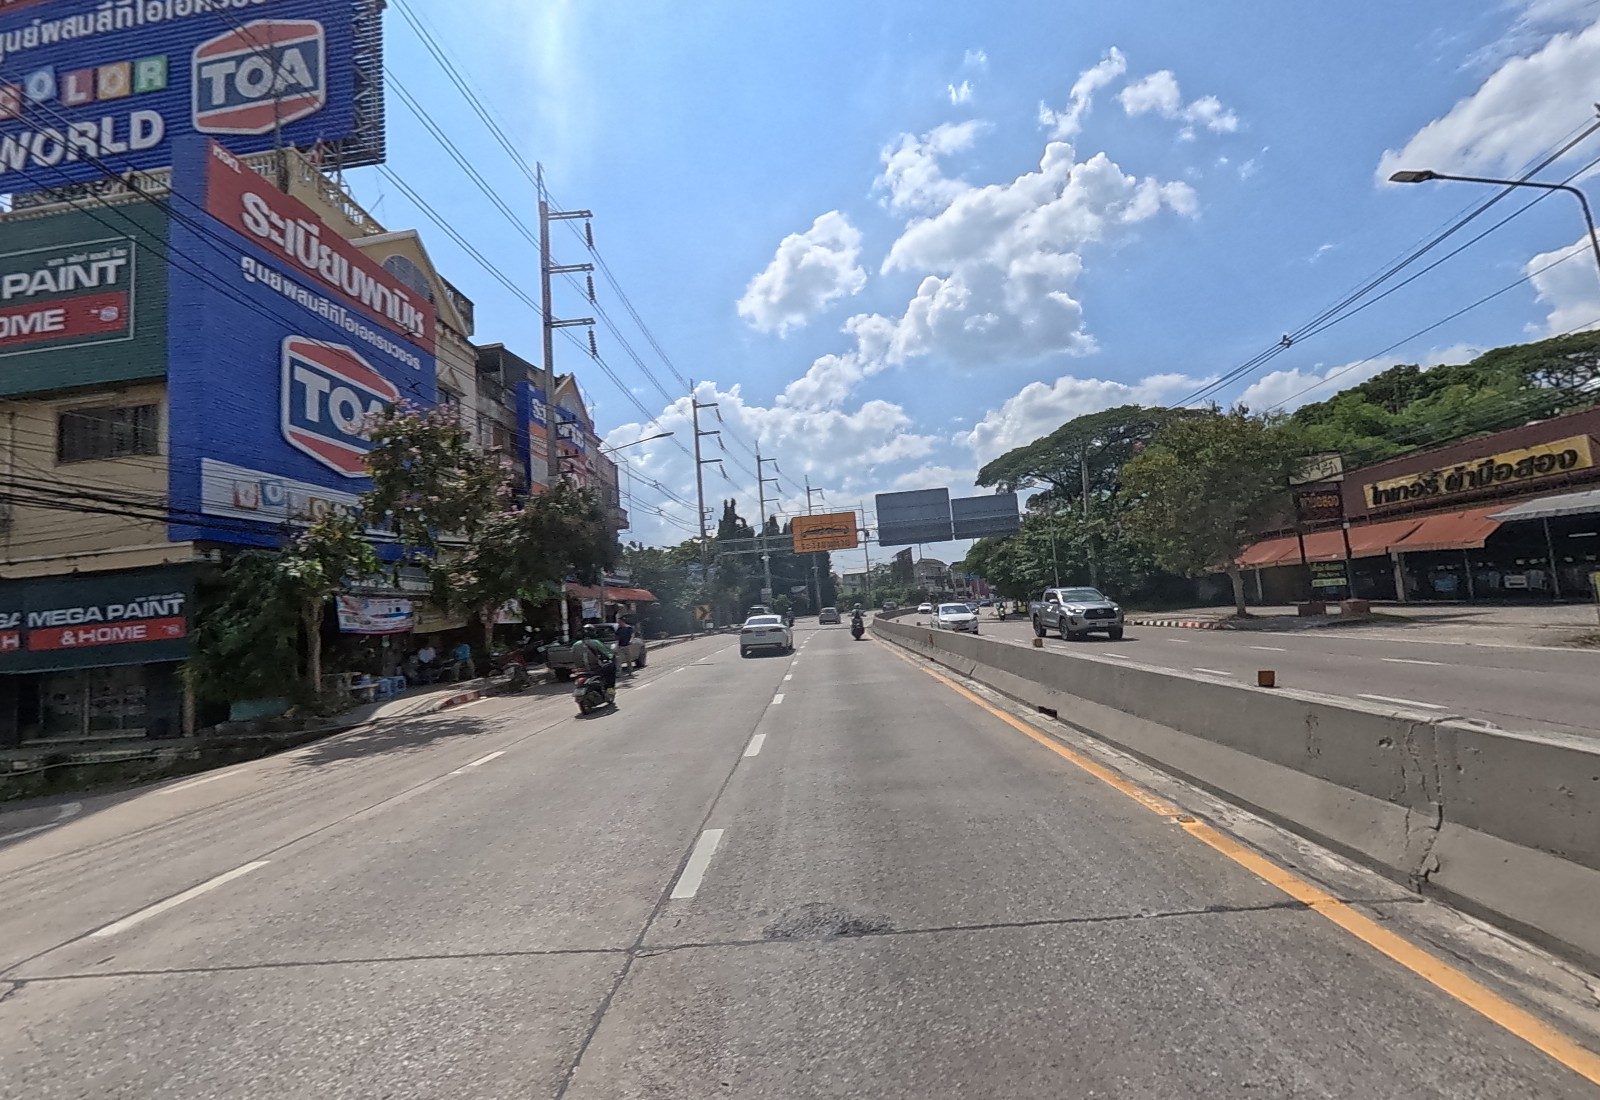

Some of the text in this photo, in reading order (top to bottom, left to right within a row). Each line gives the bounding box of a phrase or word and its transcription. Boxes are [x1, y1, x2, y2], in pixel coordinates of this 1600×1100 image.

[201, 48, 314, 106] TOA
[0, 110, 165, 173] WORLD
[2, 258, 127, 300] PAINT
[242, 192, 424, 338] ระเบียบพานิช
[29, 598, 185, 627] MEGA PAINT
[62, 625, 147, 646] & HOME
